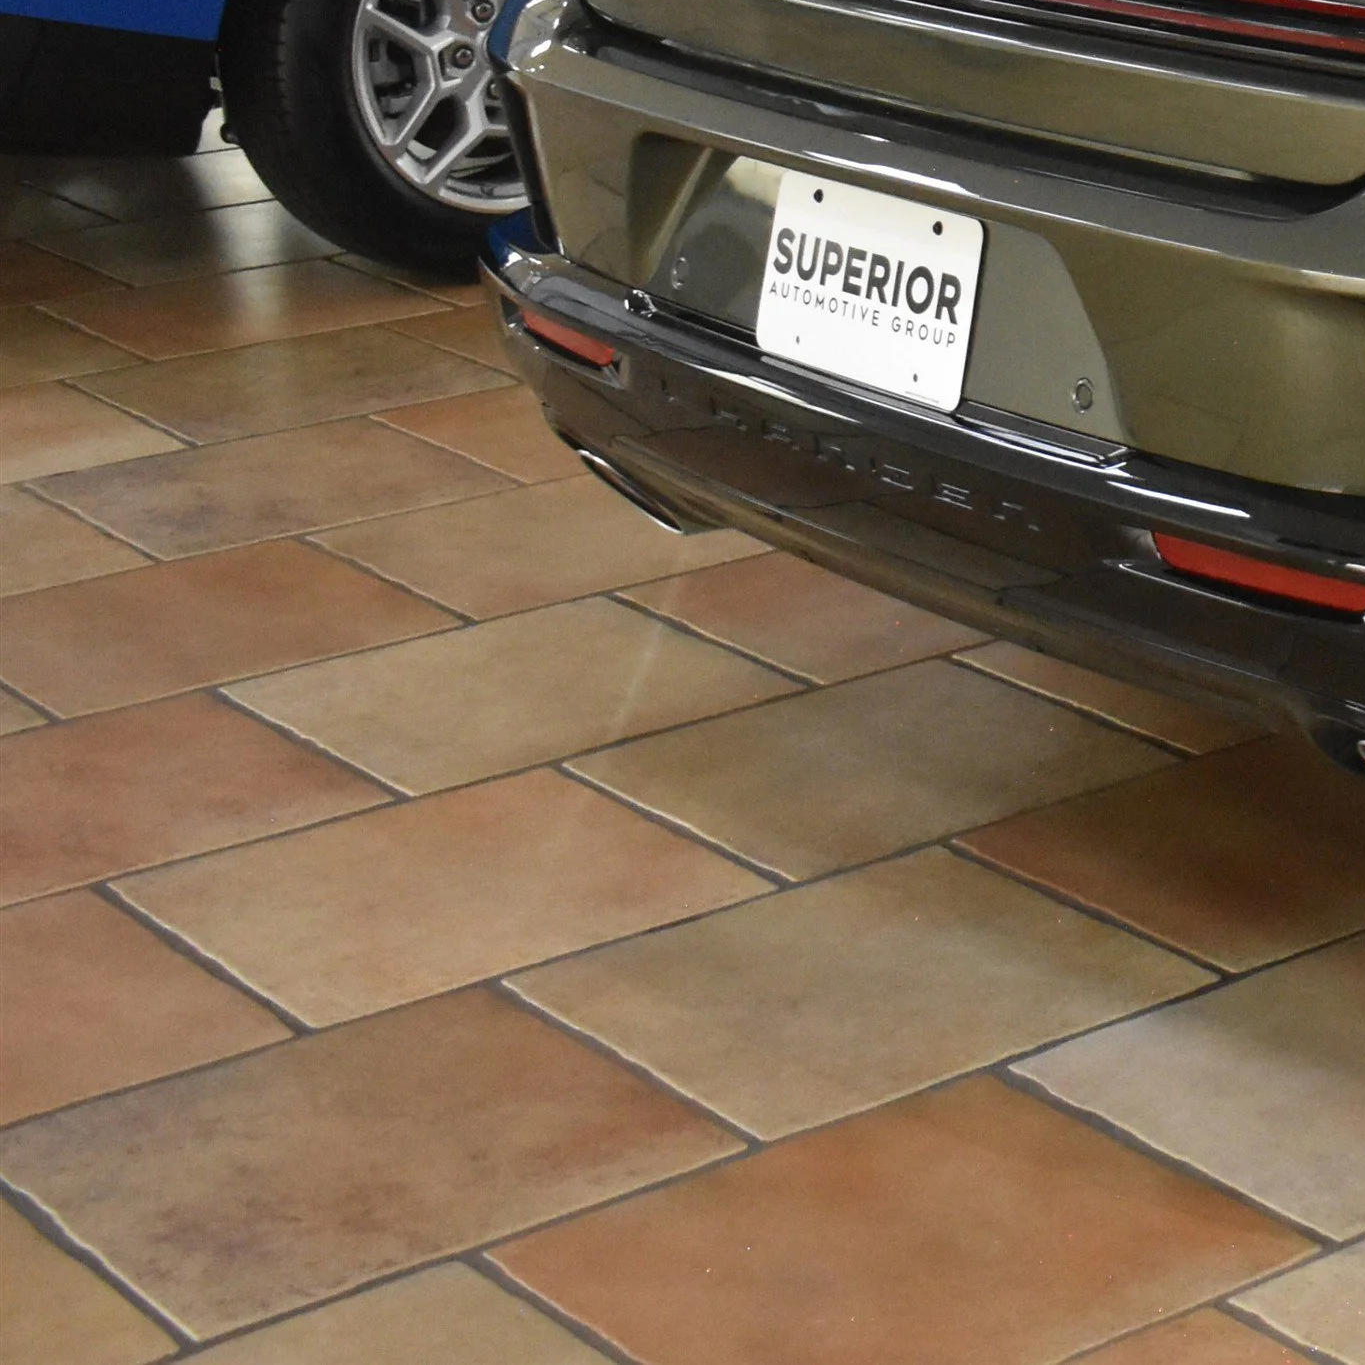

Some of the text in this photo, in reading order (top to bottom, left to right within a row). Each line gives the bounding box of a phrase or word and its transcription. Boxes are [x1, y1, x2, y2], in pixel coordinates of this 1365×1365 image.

[769, 280, 956, 348] AUTOMOTIVE GROUP
[773, 227, 962, 325] SUPERIOR
